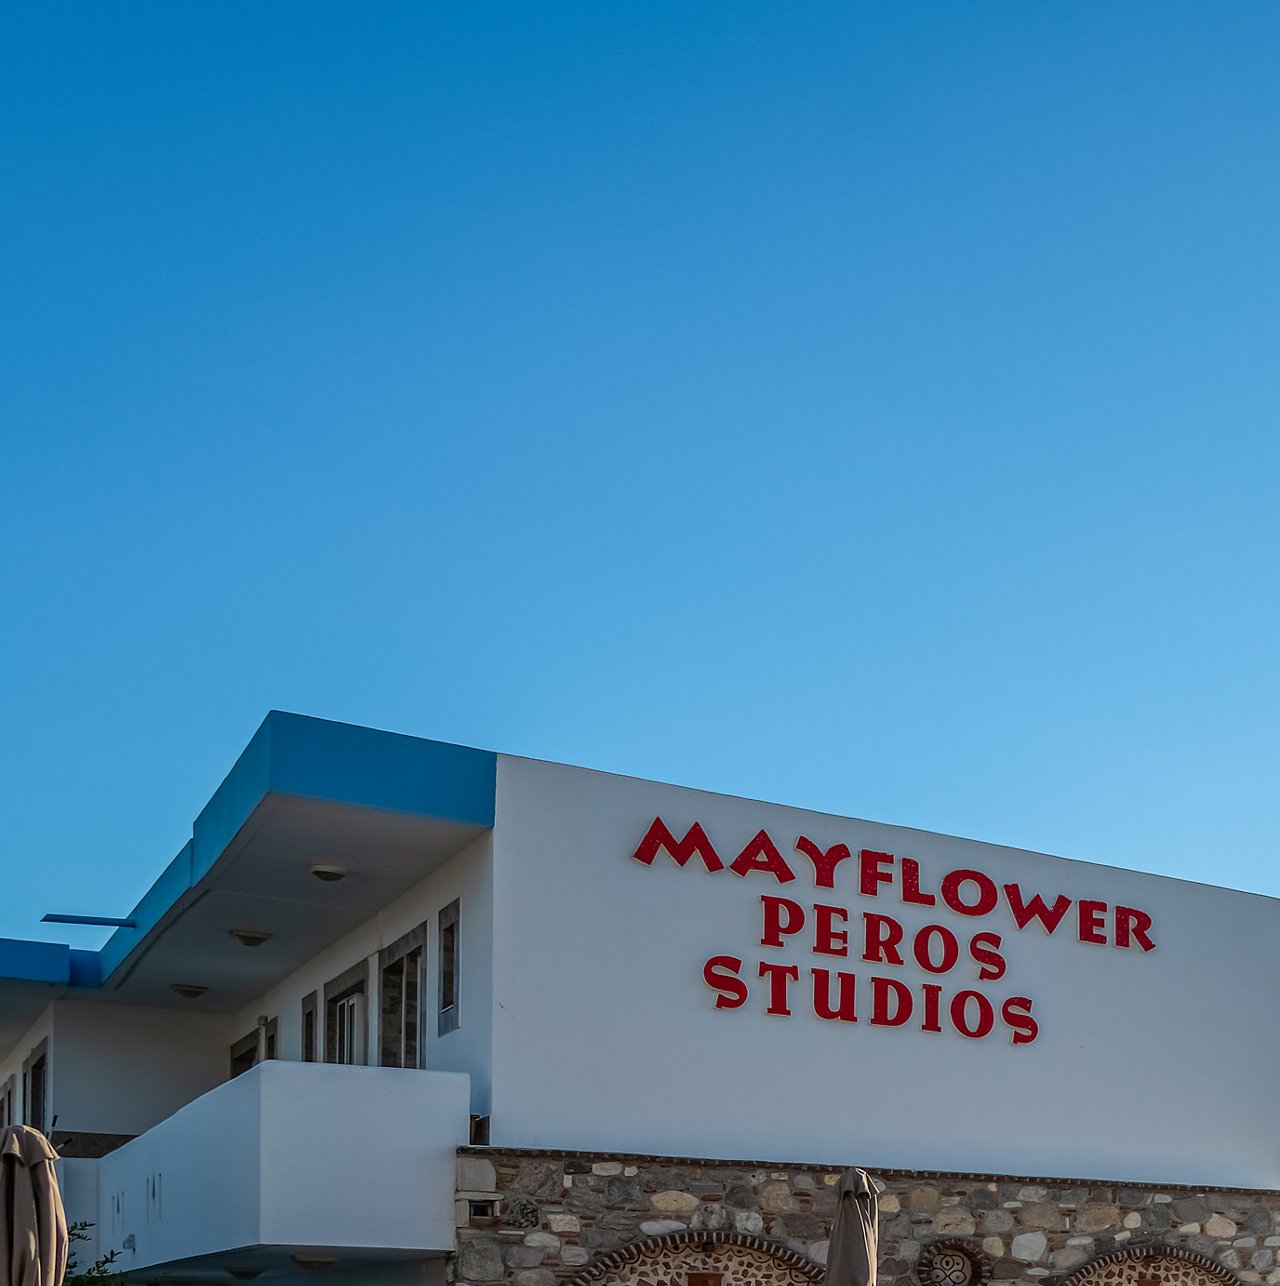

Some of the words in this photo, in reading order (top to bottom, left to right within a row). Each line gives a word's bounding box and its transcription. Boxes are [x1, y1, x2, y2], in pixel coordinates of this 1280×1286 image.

[633, 816, 1157, 953] MAYFLOWER
[760, 895, 1008, 982] PEROS
[702, 955, 1041, 1046] STUDIOS
